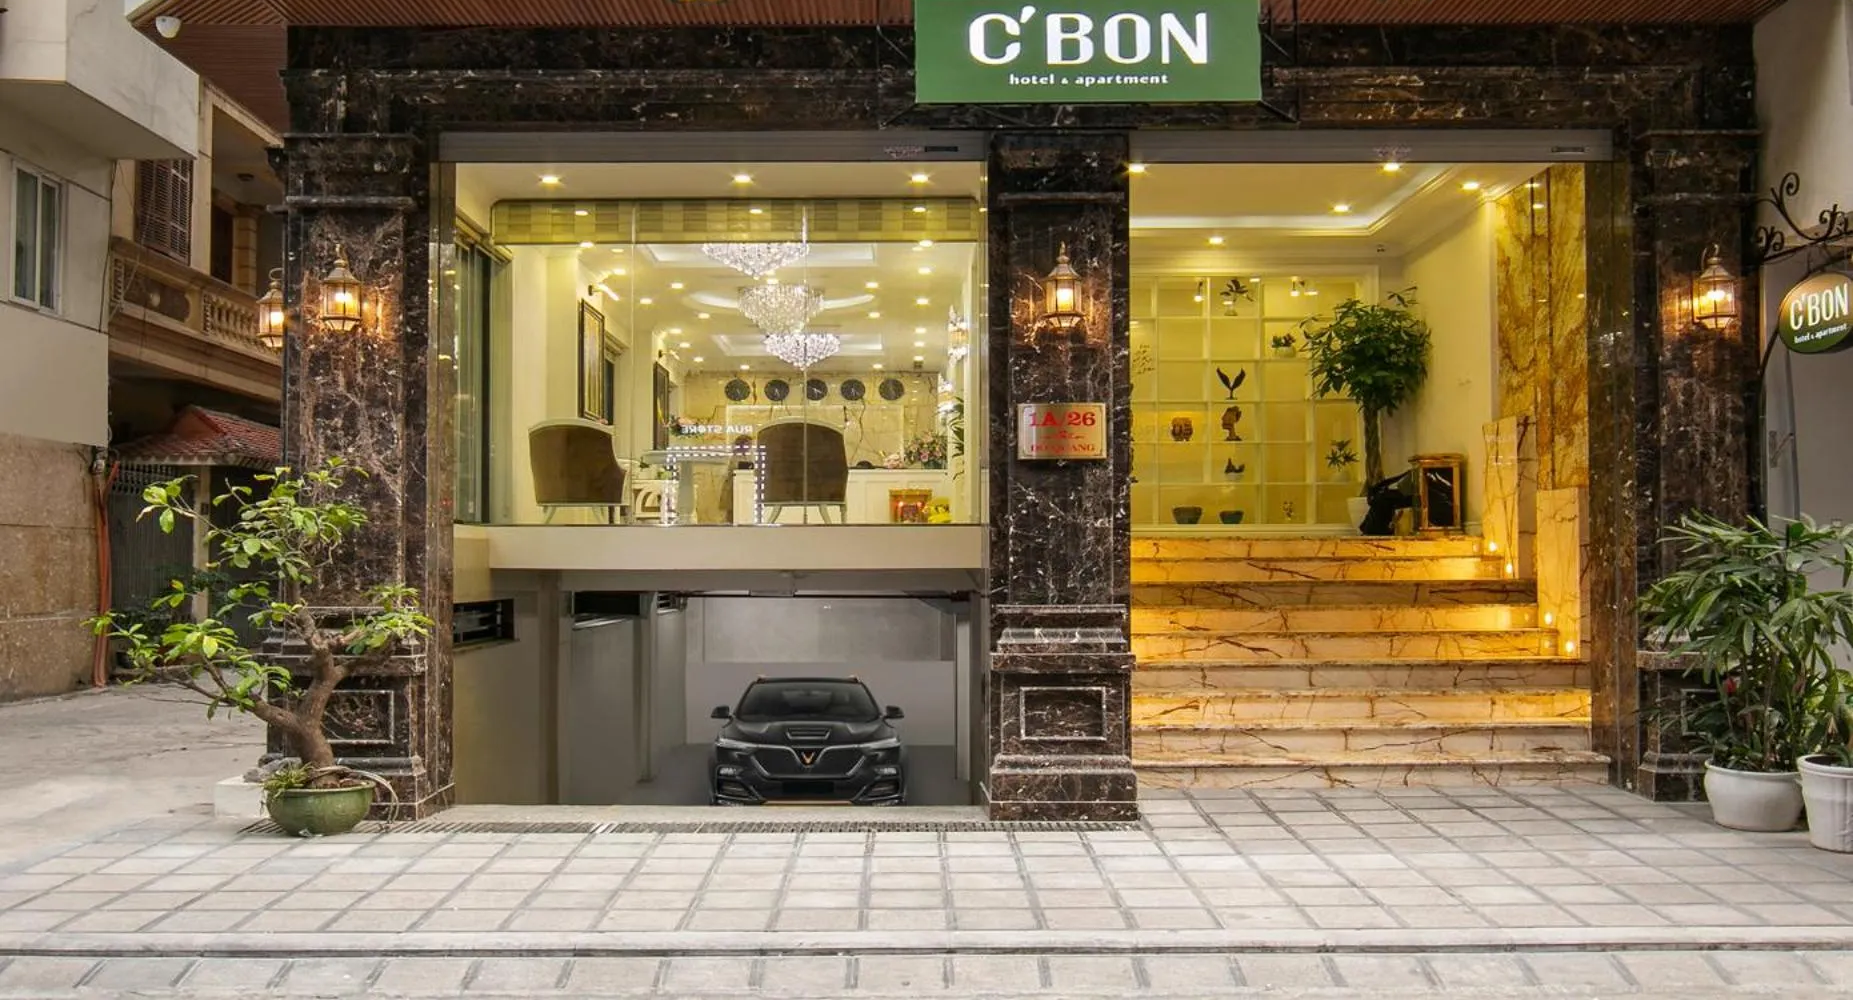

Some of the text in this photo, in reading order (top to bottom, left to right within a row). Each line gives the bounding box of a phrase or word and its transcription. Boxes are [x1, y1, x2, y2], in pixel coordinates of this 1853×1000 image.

[968, 5, 1209, 66] C'BON
[1009, 73, 1055, 86] hotel
[1075, 73, 1169, 87] apartment
[1789, 283, 1849, 331] C'BON
